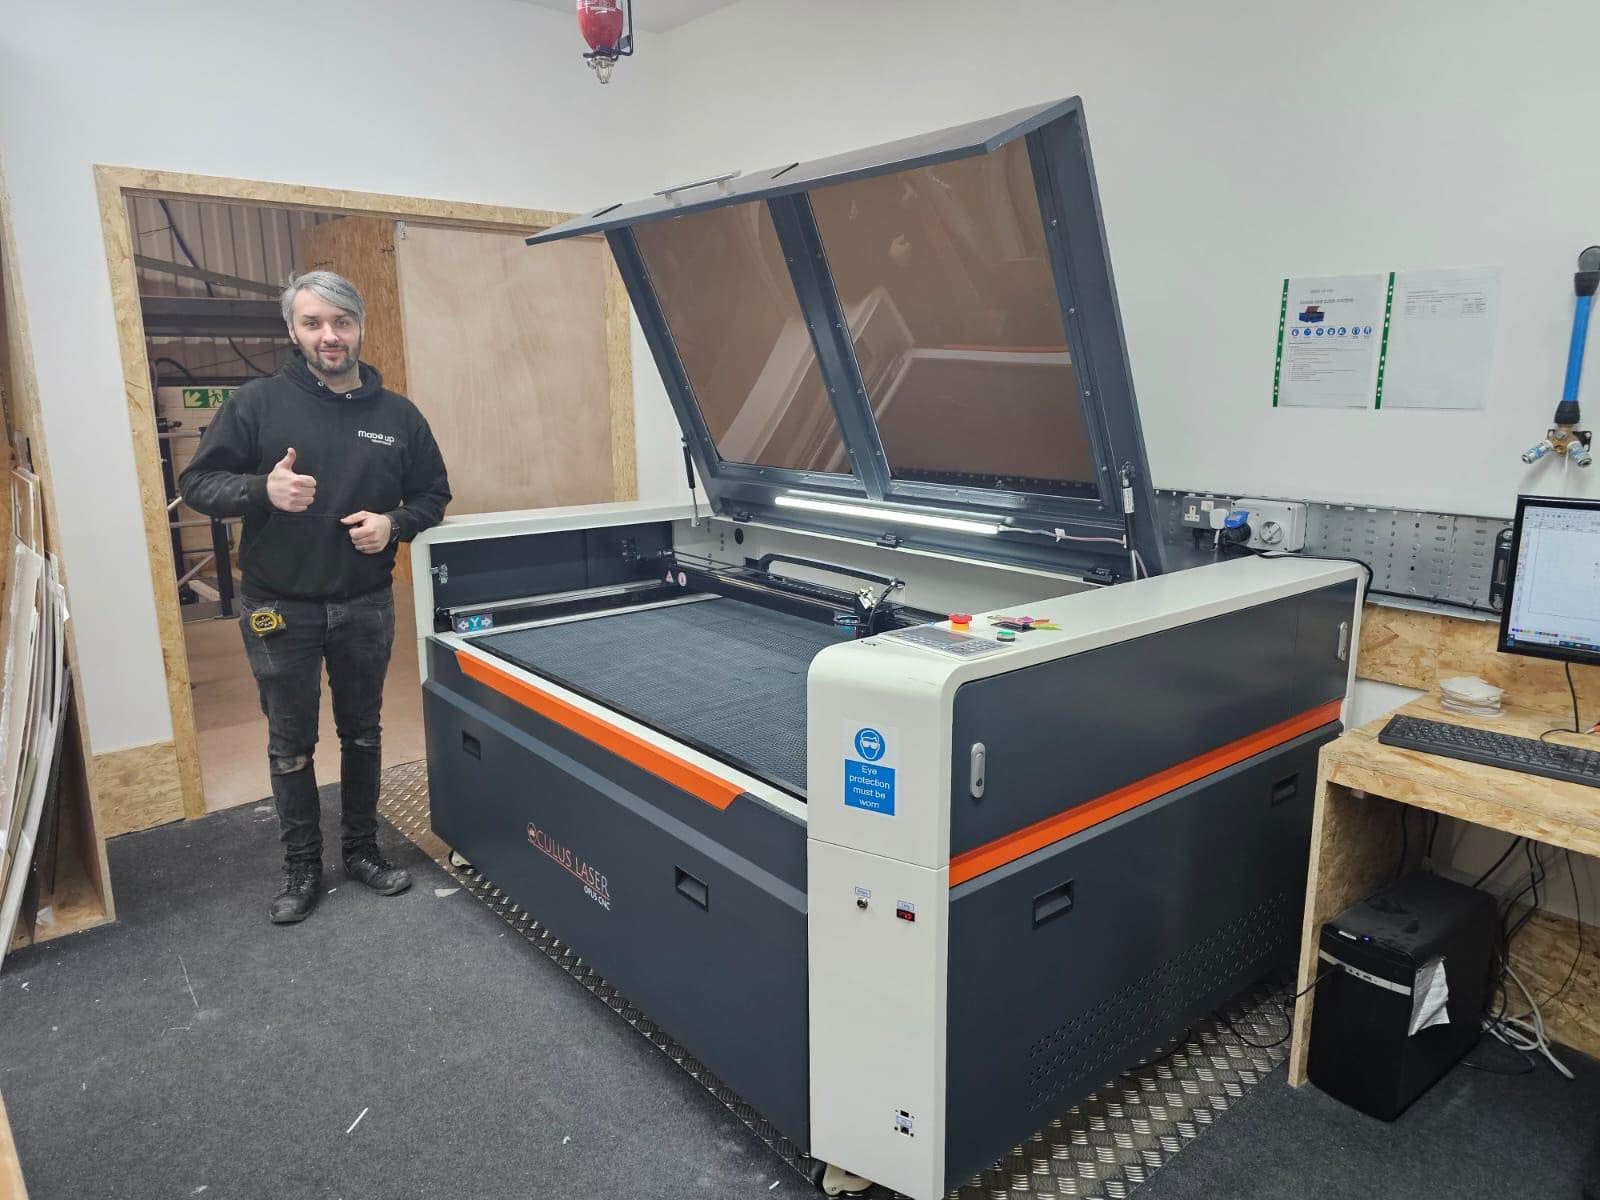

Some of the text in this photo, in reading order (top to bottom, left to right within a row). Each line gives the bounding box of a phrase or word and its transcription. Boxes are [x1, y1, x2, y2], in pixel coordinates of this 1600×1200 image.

[470, 617, 480, 627] Y
[861, 765, 878, 775] Eye
[849, 775, 890, 789] protection
[853, 786, 886, 799] must be
[859, 799, 880, 809] worn
[575, 856, 610, 898] LASER
